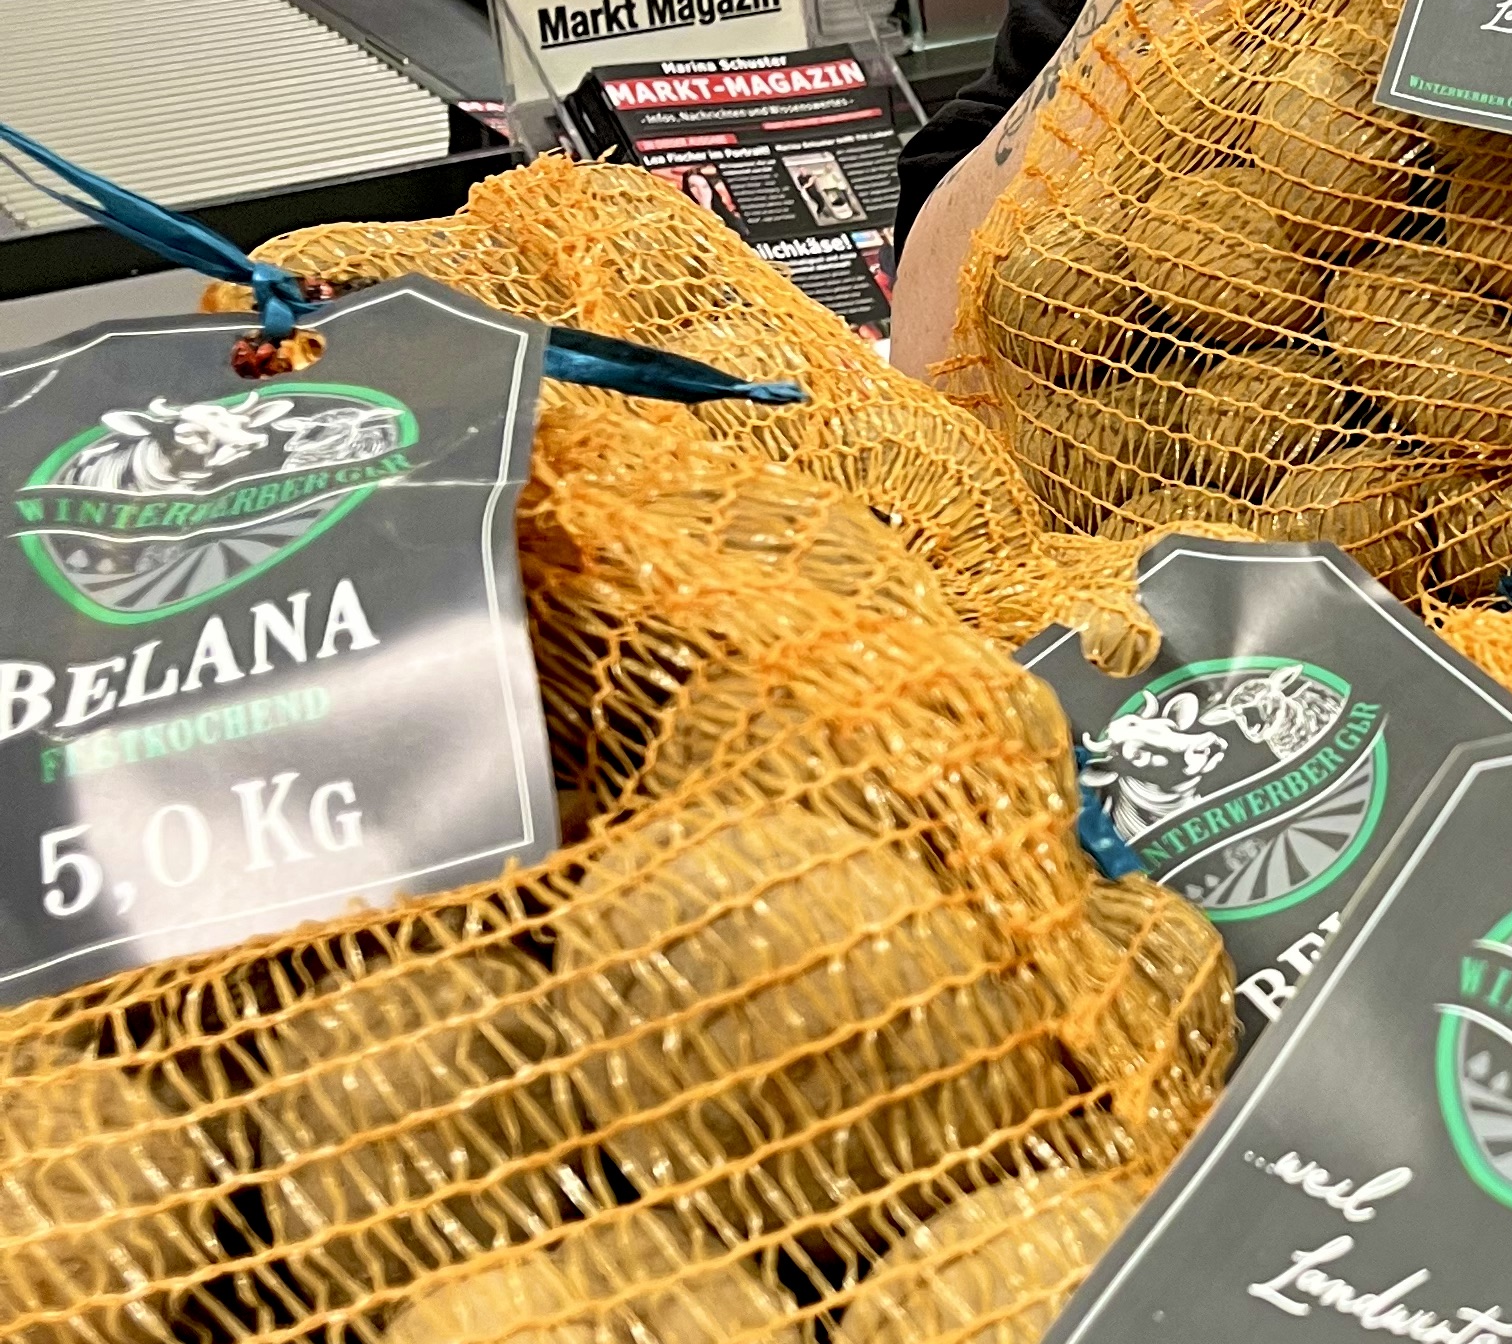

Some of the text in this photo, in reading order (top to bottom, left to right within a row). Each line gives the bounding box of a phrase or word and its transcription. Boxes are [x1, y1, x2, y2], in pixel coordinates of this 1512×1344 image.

[604, 61, 866, 107] MARKT-MAGAZIN
[718, 55, 788, 72] Schuster
[0, 577, 381, 743] BELANA
[39, 770, 365, 920] 5,0 KG
[1235, 911, 1342, 1023] BE
